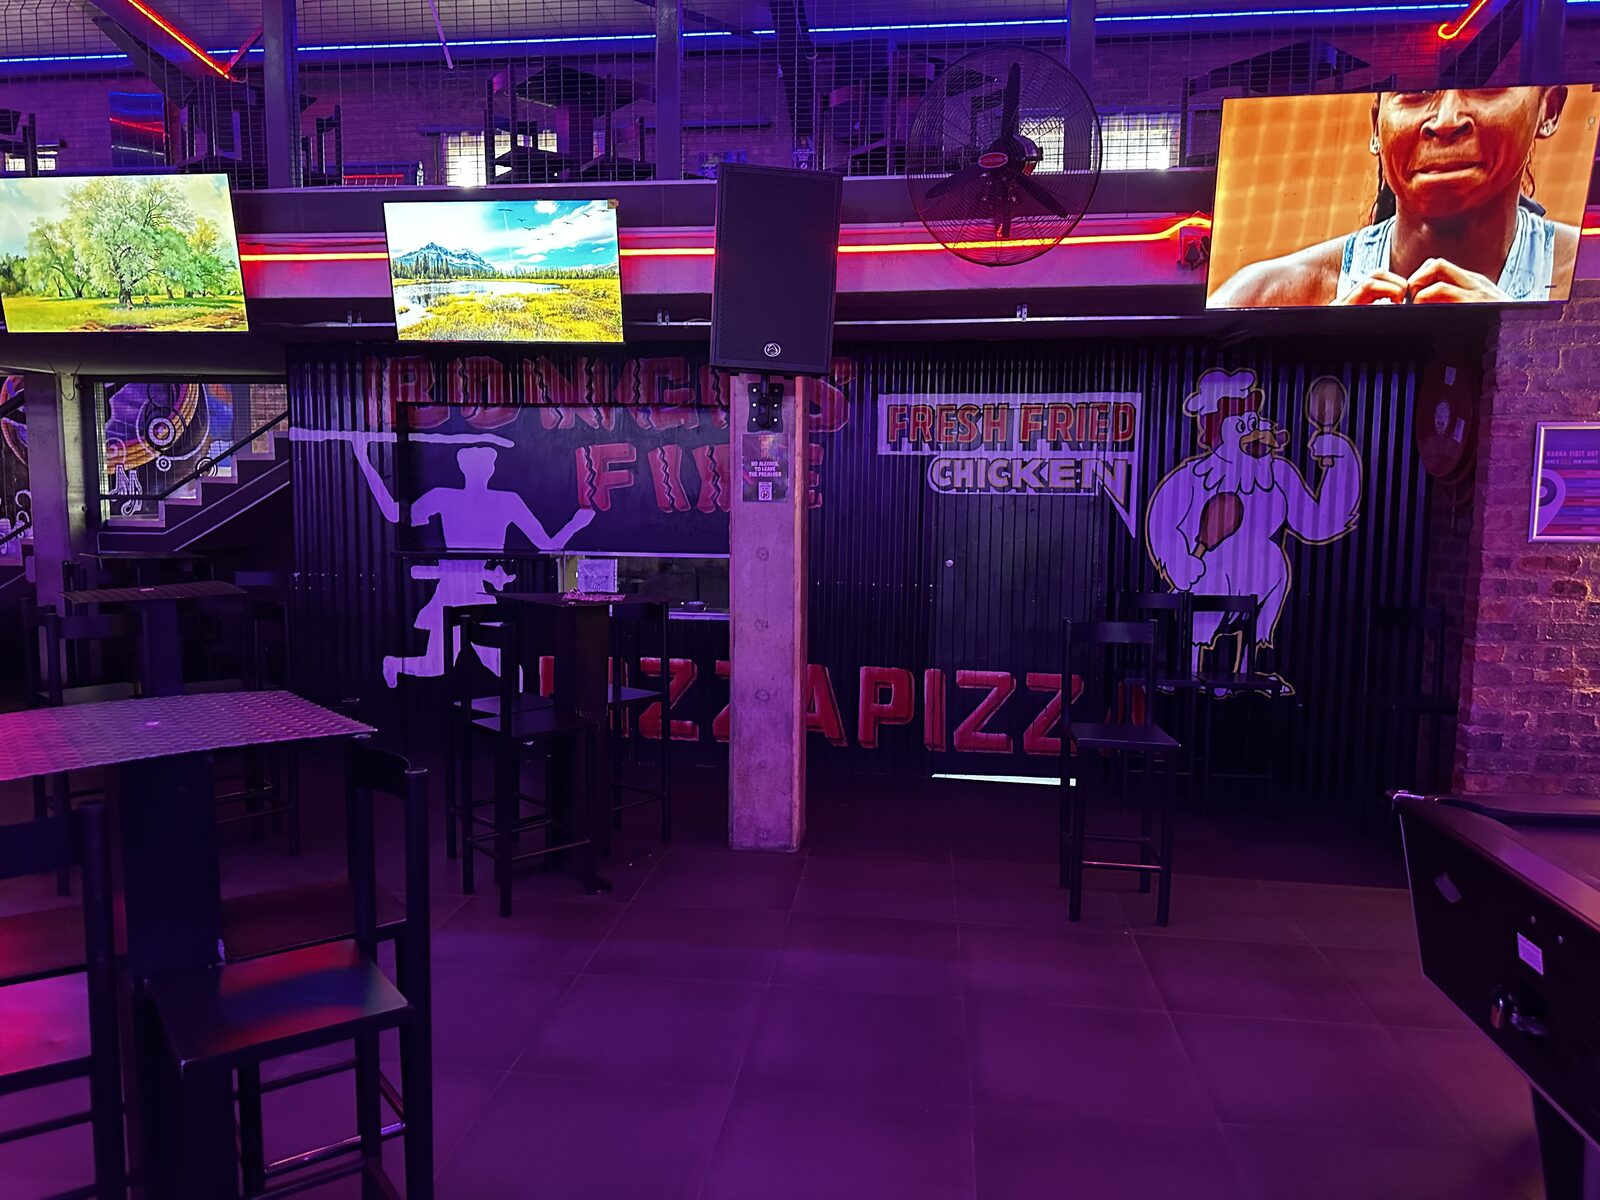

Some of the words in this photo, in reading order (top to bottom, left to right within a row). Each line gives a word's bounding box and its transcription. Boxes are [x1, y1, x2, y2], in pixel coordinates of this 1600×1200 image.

[887, 403, 1009, 447] FRESH
[1020, 402, 1136, 446] FRIED
[930, 457, 1130, 507] CHICKEN
